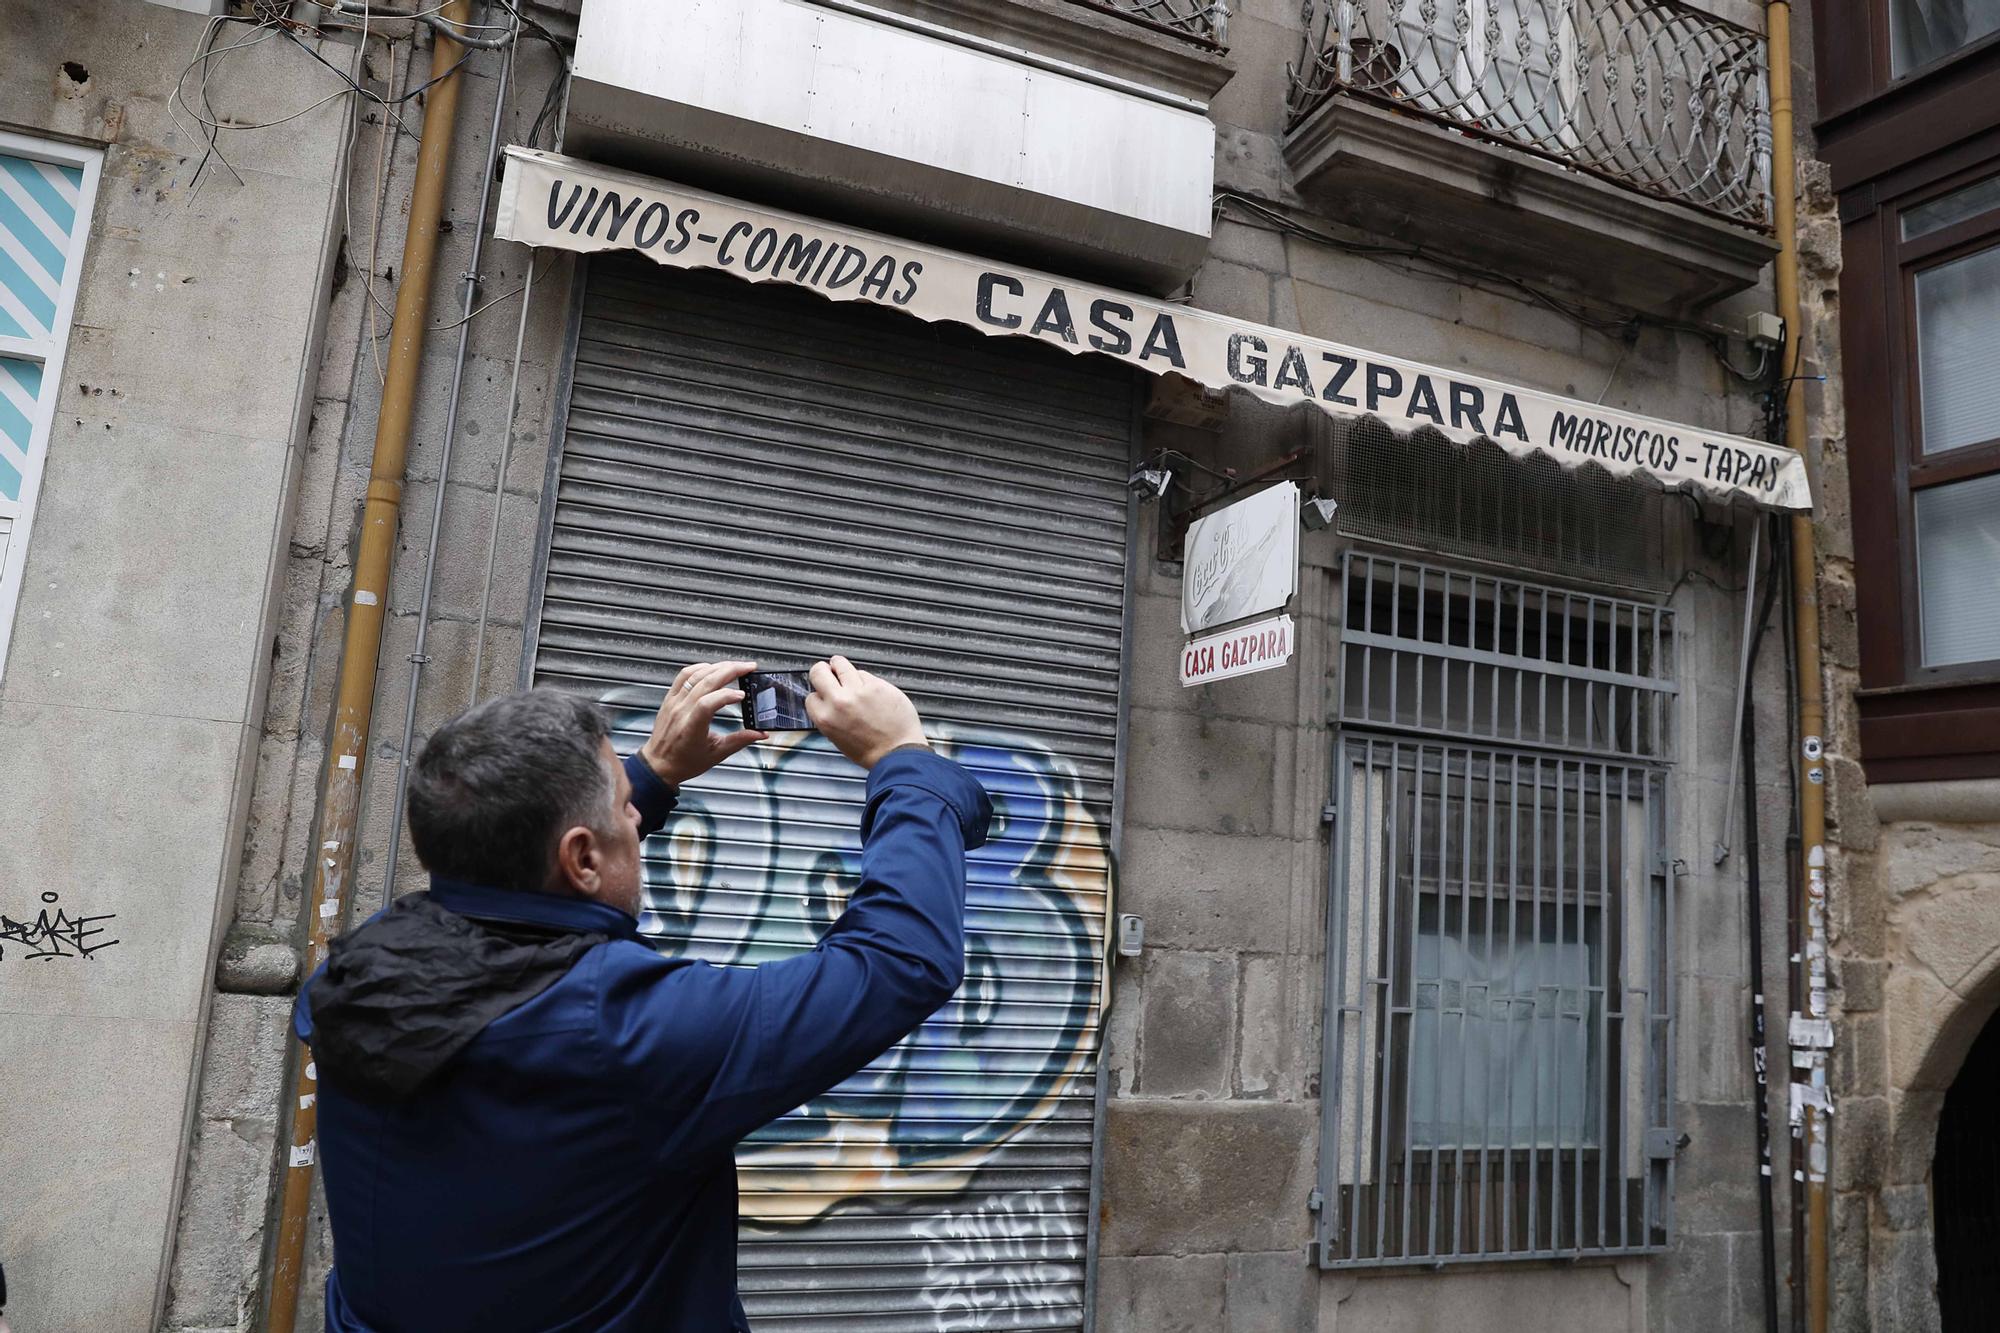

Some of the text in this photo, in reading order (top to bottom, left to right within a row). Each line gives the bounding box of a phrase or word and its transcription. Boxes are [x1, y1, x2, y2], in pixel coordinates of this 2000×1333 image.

[976, 271, 1186, 369] CASA
[1227, 332, 1529, 443] GAZPARA
[1185, 627, 1286, 677] CASA GAZPARA
